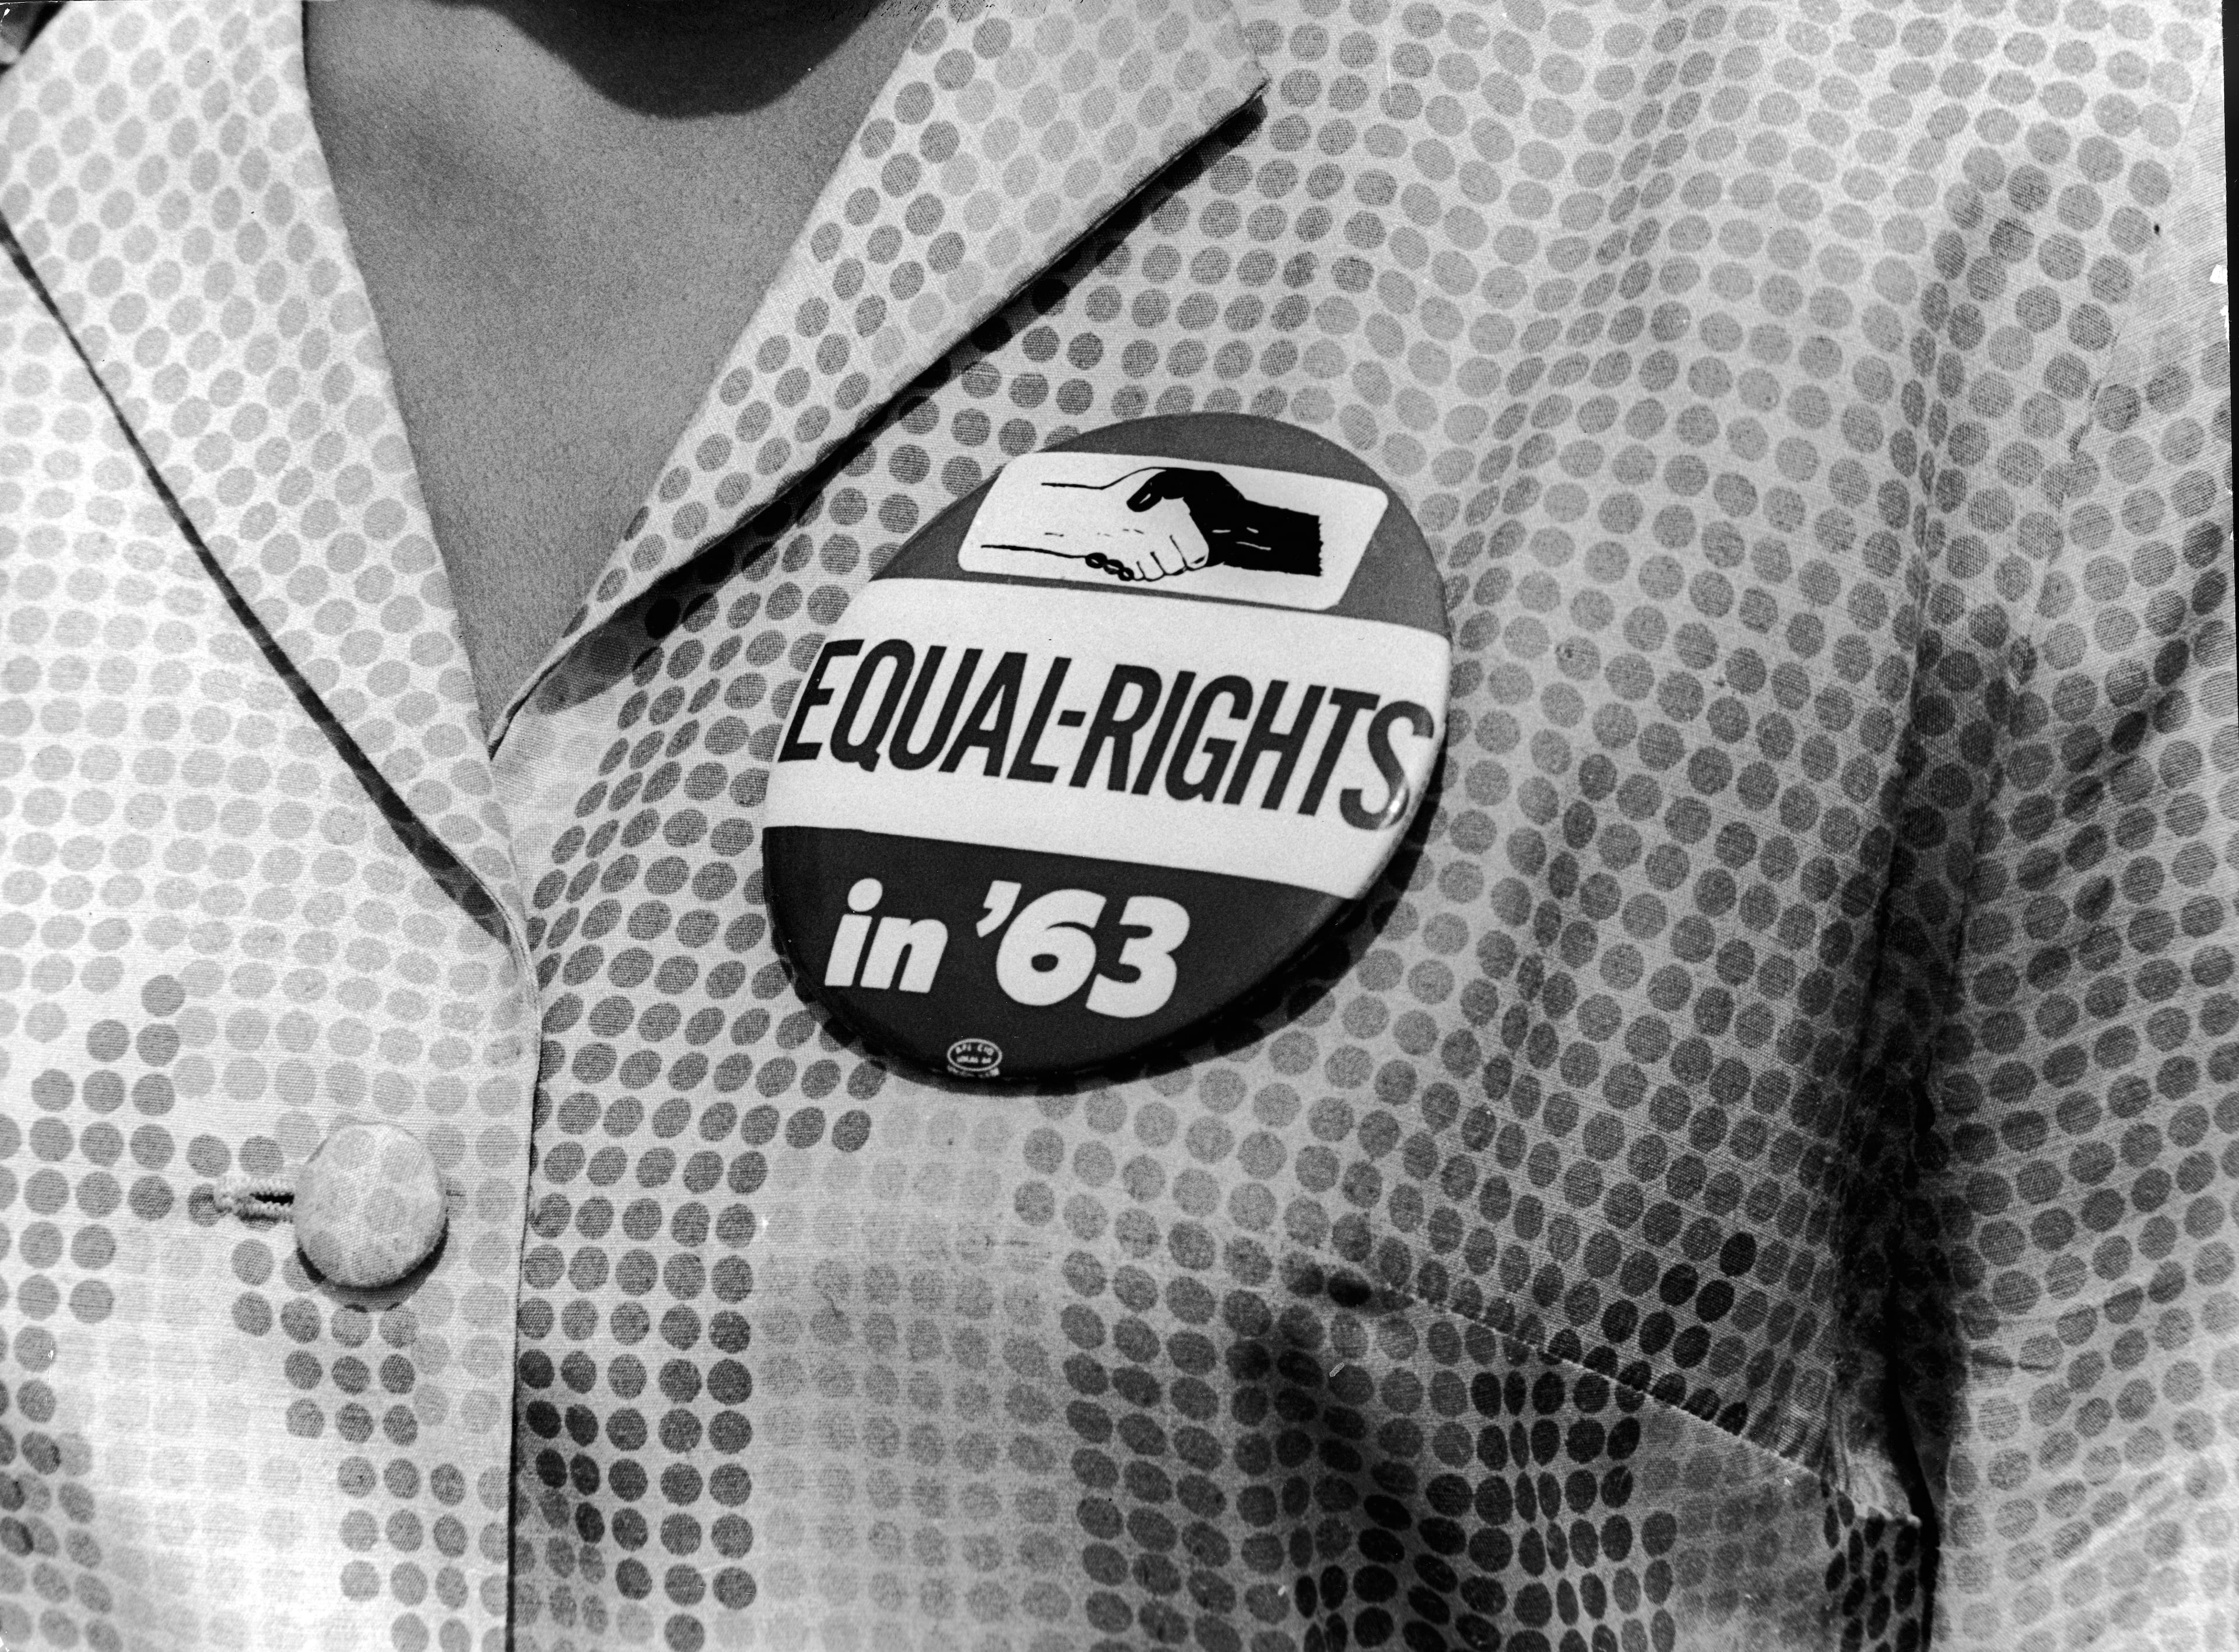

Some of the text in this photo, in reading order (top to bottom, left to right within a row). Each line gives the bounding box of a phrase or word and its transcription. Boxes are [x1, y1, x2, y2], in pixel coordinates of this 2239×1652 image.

[777, 638, 1434, 831] EQUAL-RIGHTS
[824, 878, 1190, 1018] in '63
